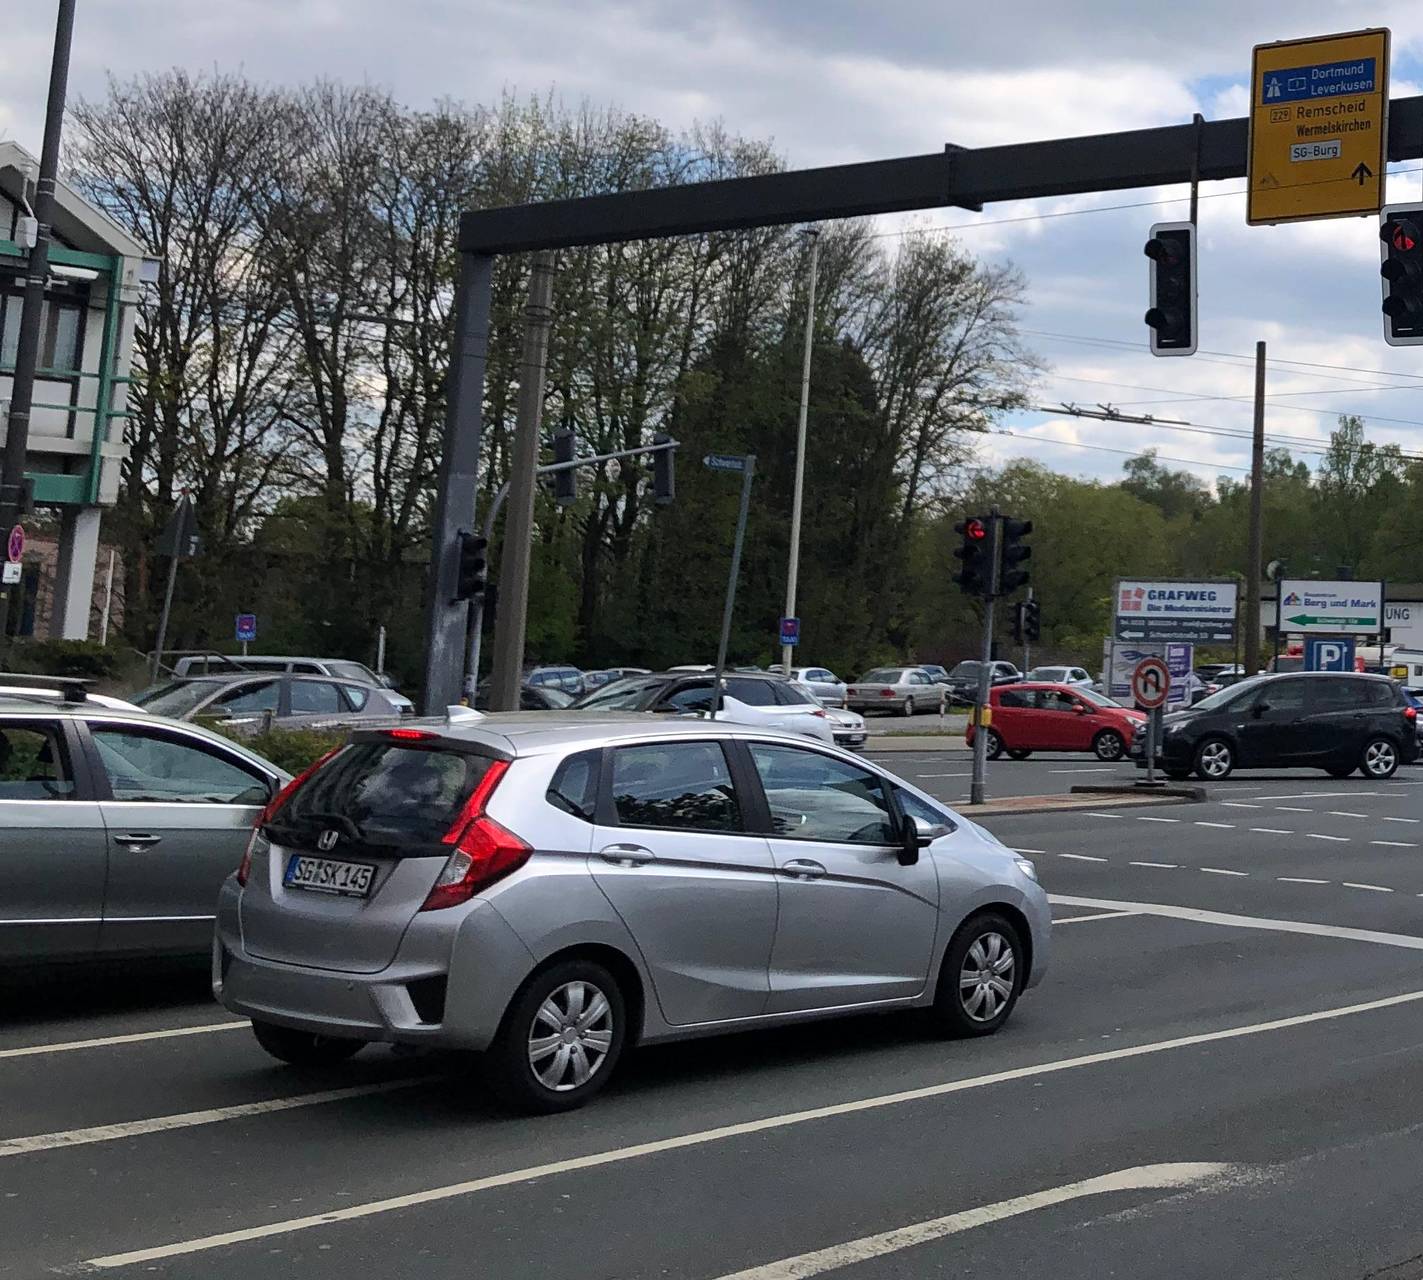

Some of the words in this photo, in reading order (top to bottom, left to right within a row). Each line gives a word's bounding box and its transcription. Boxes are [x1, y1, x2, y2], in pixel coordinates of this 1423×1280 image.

[1311, 63, 1364, 80] Dortmund
[1311, 80, 1373, 96] Leverkusen
[1296, 100, 1366, 119] Remscheid
[1296, 119, 1371, 137] Wermelskirchen
[1293, 145, 1338, 159] SG-Burg
[1147, 590, 1217, 601] GRAFWEG
[1304, 598, 1327, 608] Berg
[1330, 599, 1347, 607] und
[1350, 600, 1376, 608] Mark
[1385, 608, 1410, 620] UNG
[340, 866, 371, 889] 145
